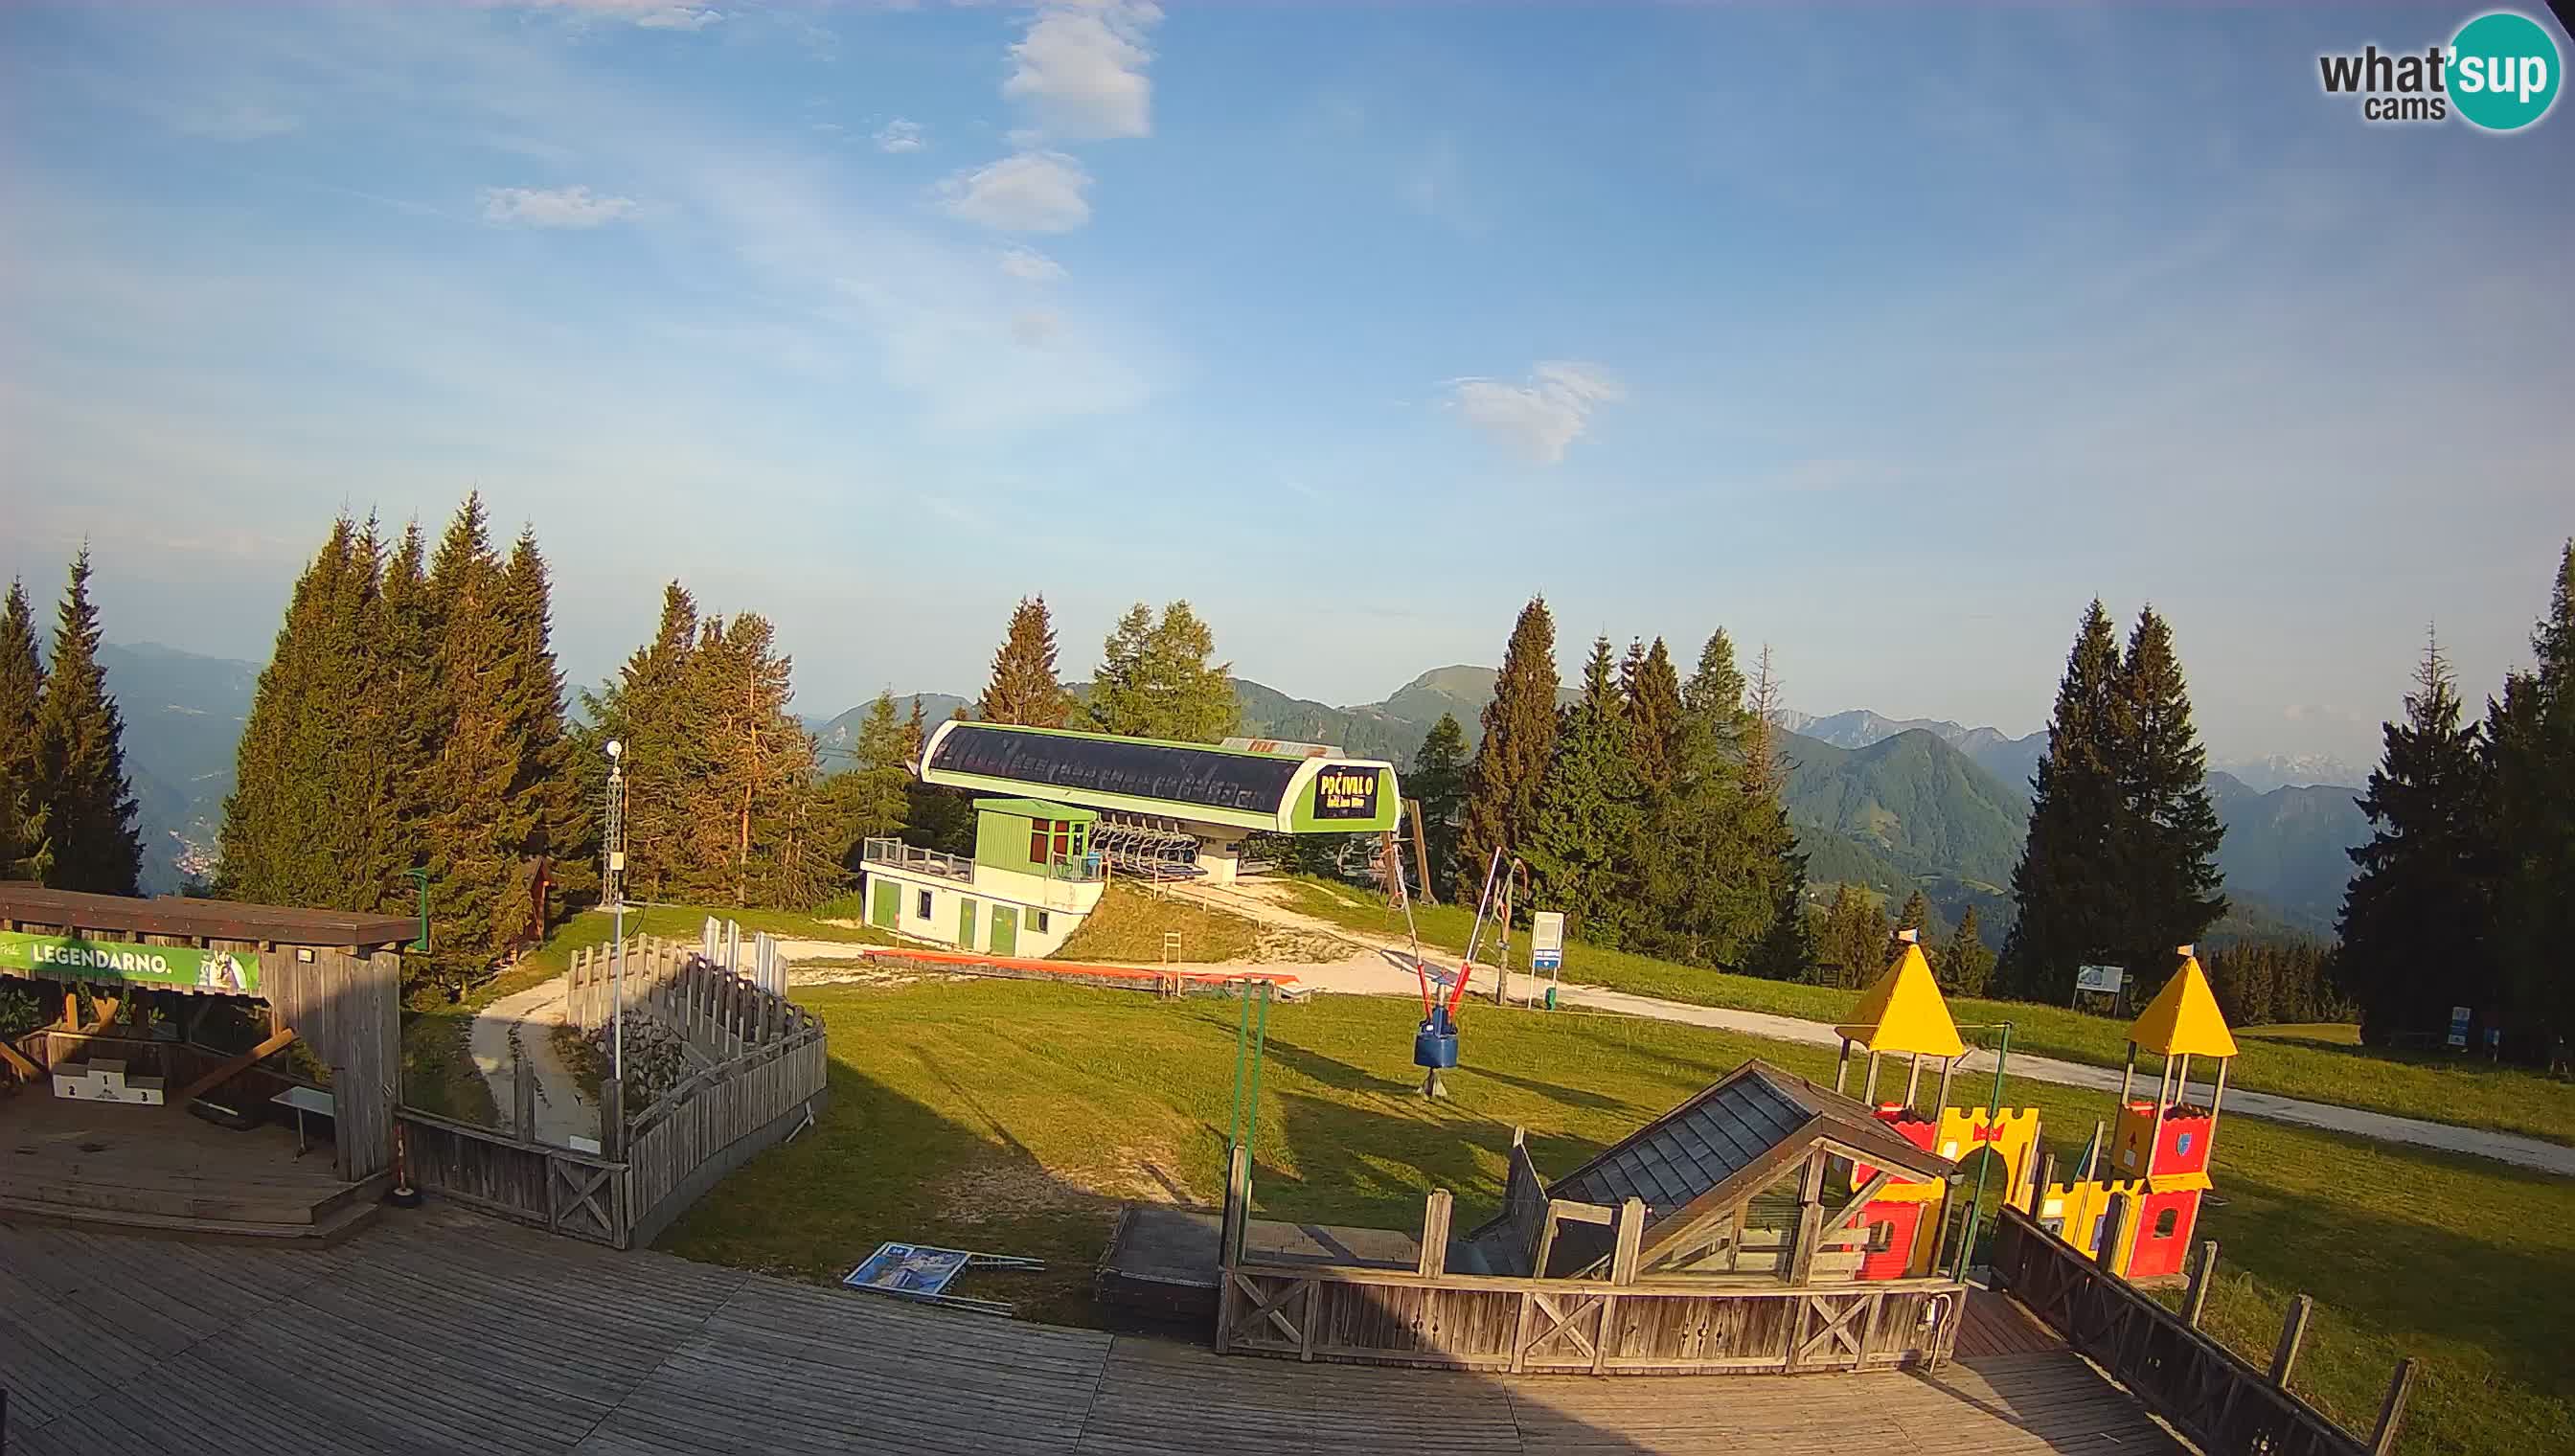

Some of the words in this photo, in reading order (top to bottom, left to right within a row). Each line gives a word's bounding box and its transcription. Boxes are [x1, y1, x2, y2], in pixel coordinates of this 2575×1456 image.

[33, 944, 172, 975] LEGENDARNO.
[68, 1085, 76, 1096] 2
[141, 1091, 148, 1102] 3
